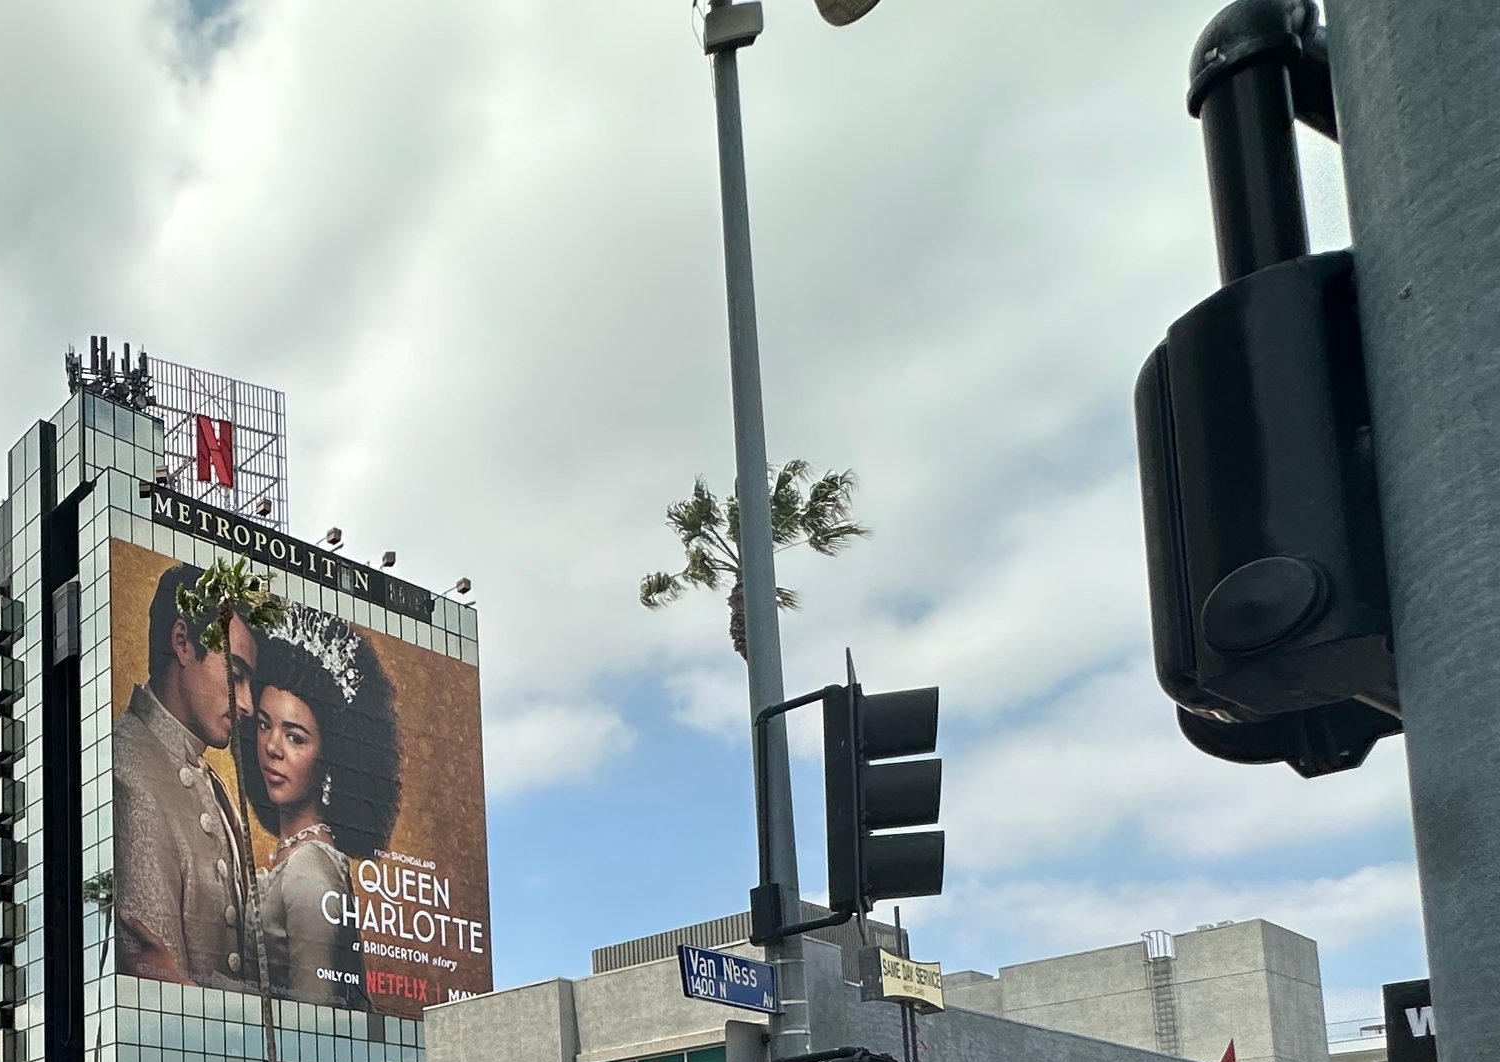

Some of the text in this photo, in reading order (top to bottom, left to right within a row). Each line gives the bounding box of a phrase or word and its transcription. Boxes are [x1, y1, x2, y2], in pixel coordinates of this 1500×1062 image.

[154, 492, 370, 592] METROPOLITN
[358, 859, 451, 910] QUEEN
[321, 890, 484, 954] CHARLOTTE
[352, 940, 458, 972] a BRIDGERTON story
[689, 949, 758, 988] Van Ness
[882, 958, 901, 980] SAME
[915, 966, 941, 989] SERVICE
[317, 968, 342, 982] ONLY
[344, 971, 360, 985] ON
[366, 970, 429, 1003] NETFLIX
[690, 976, 727, 999] 1400 N
[763, 991, 774, 1009] Av
